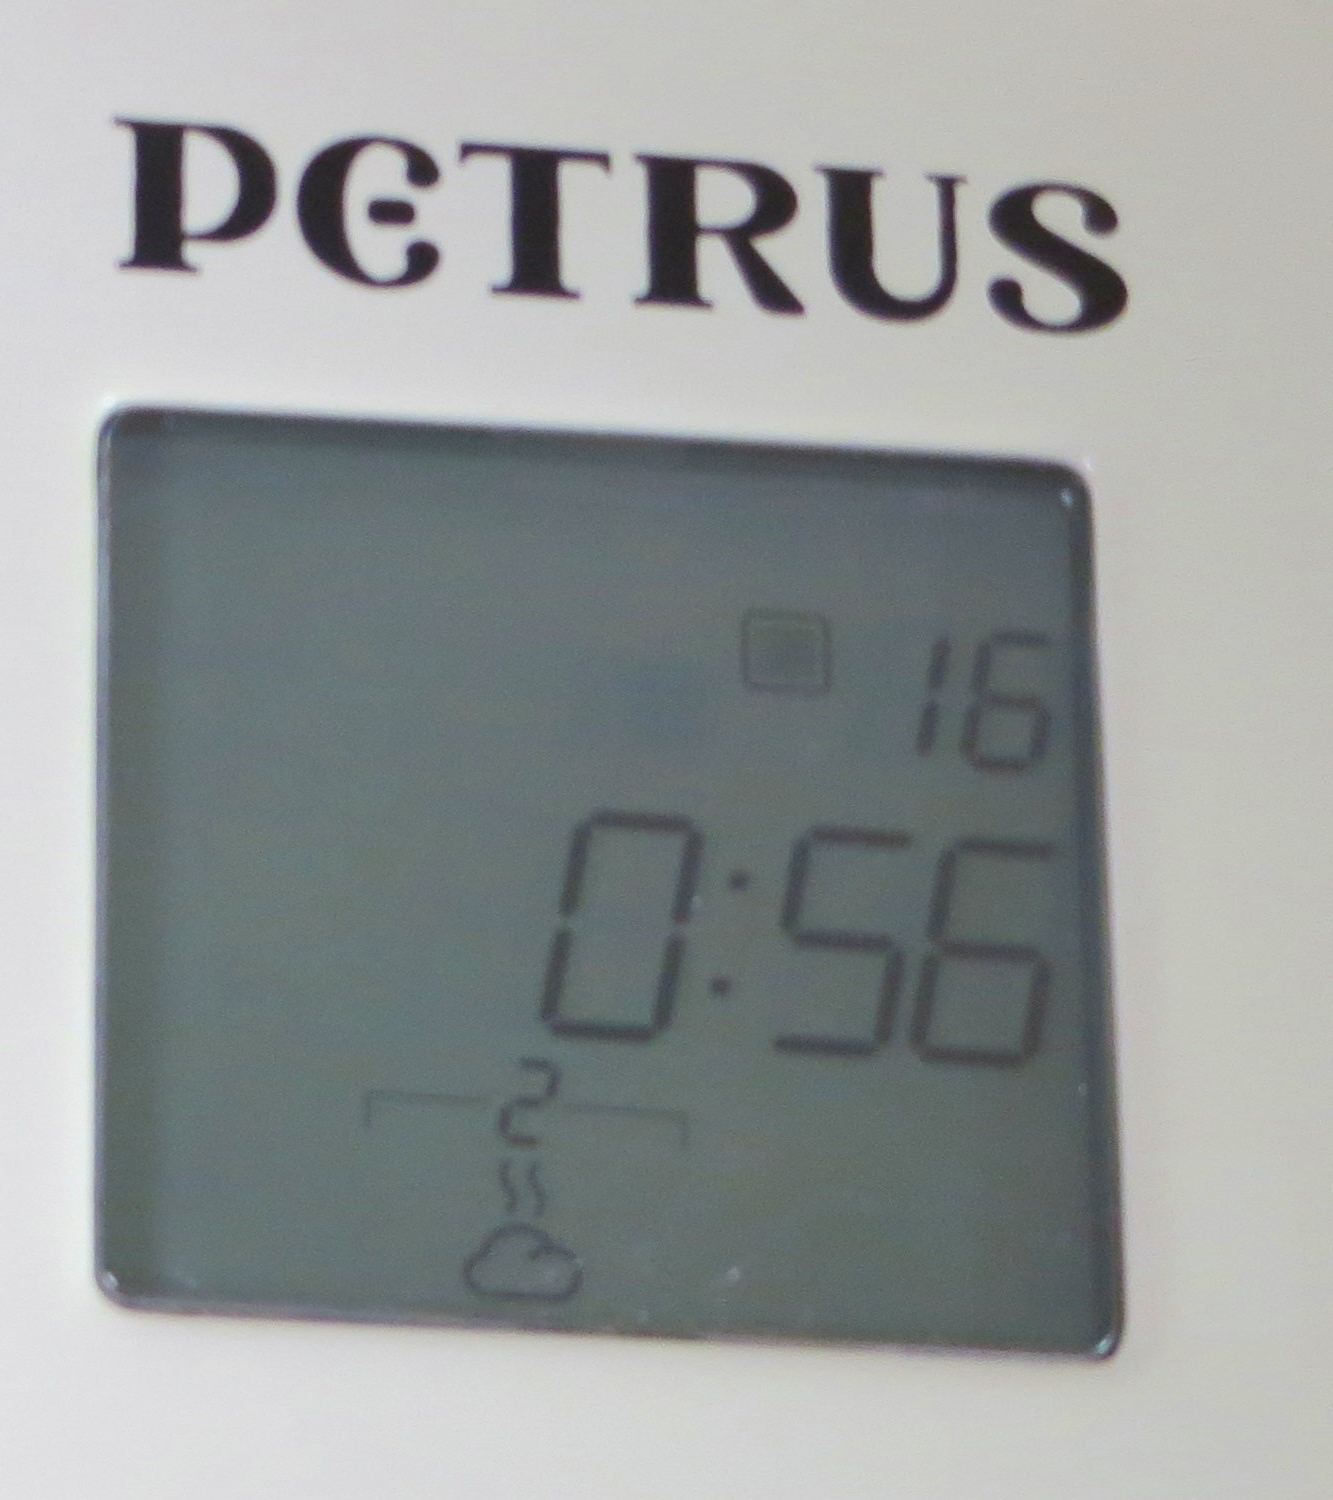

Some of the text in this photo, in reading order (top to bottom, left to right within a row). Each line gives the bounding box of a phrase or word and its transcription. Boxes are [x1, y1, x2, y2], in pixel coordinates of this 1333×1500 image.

[116, 116, 1130, 335] PETRUS
[916, 630, 1053, 776] 16
[540, 807, 1058, 1069] 0:56
